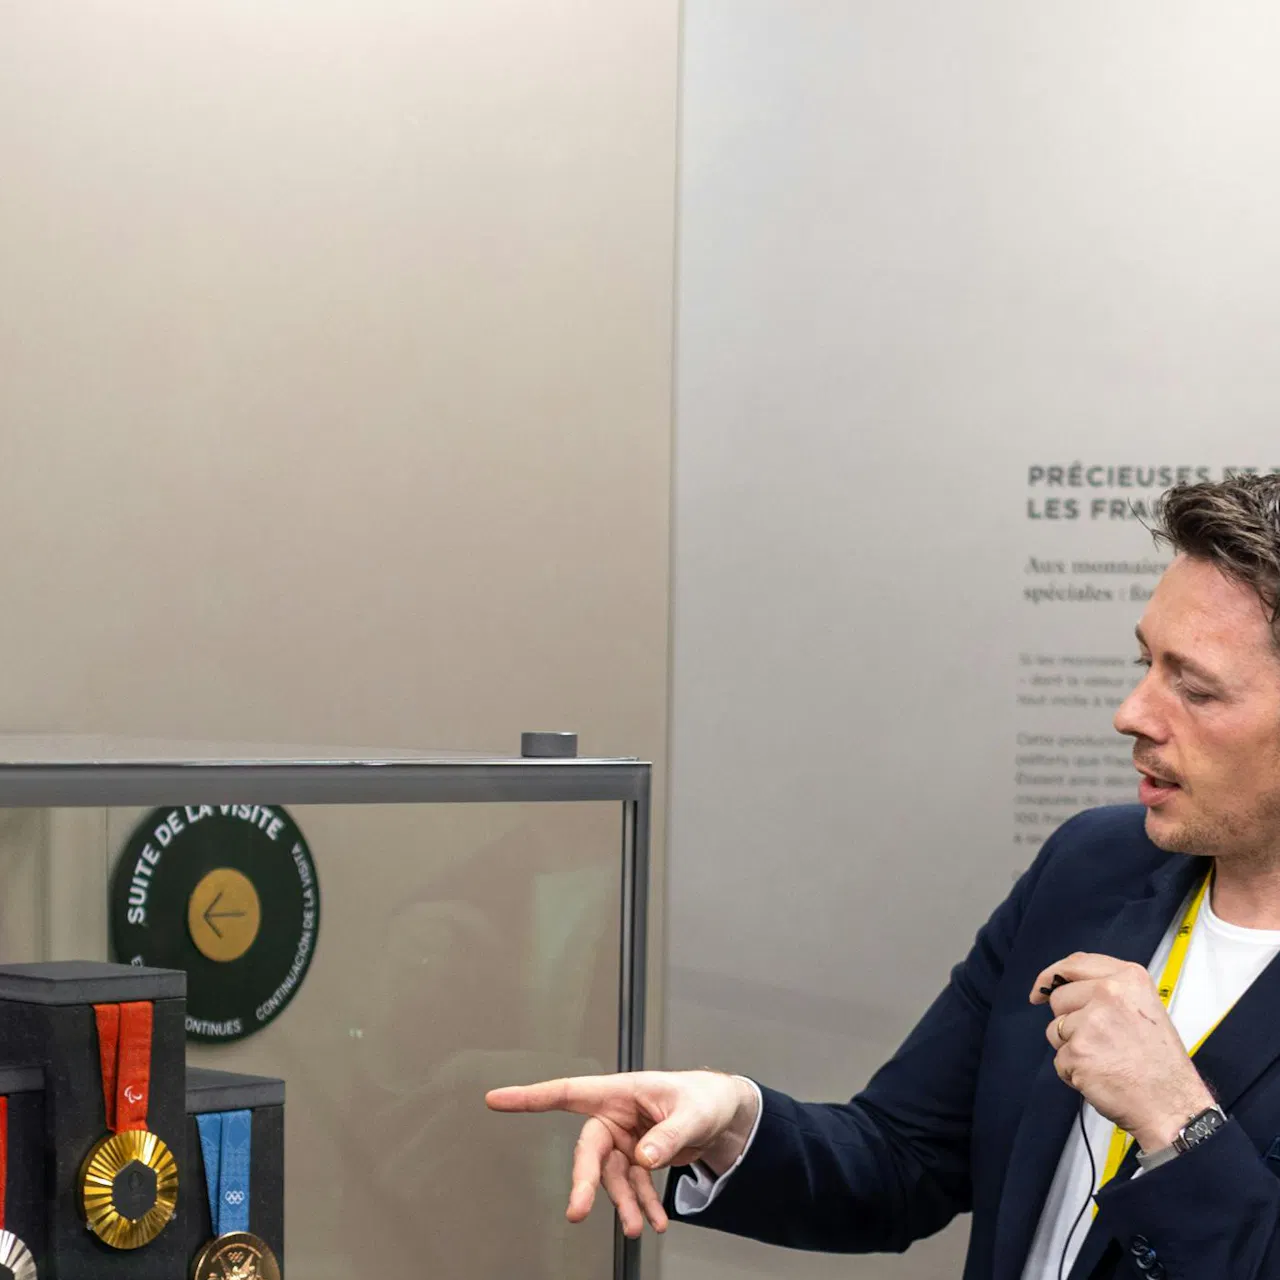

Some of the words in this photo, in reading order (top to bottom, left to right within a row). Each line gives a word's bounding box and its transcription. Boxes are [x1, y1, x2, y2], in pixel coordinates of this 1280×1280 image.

[1028, 459, 1211, 487] PRÉCIEUSES
[1027, 499, 1081, 520] LES
[1090, 500, 1165, 520] FRA
[128, 844, 161, 925] SUITE
[155, 810, 186, 848] DE
[184, 804, 215, 824] LA
[220, 804, 285, 841] VISITE
[290, 841, 316, 889] VISITA
[302, 888, 317, 909] LA
[303, 910, 317, 930] DE
[185, 1017, 242, 1036] ONTINUES
